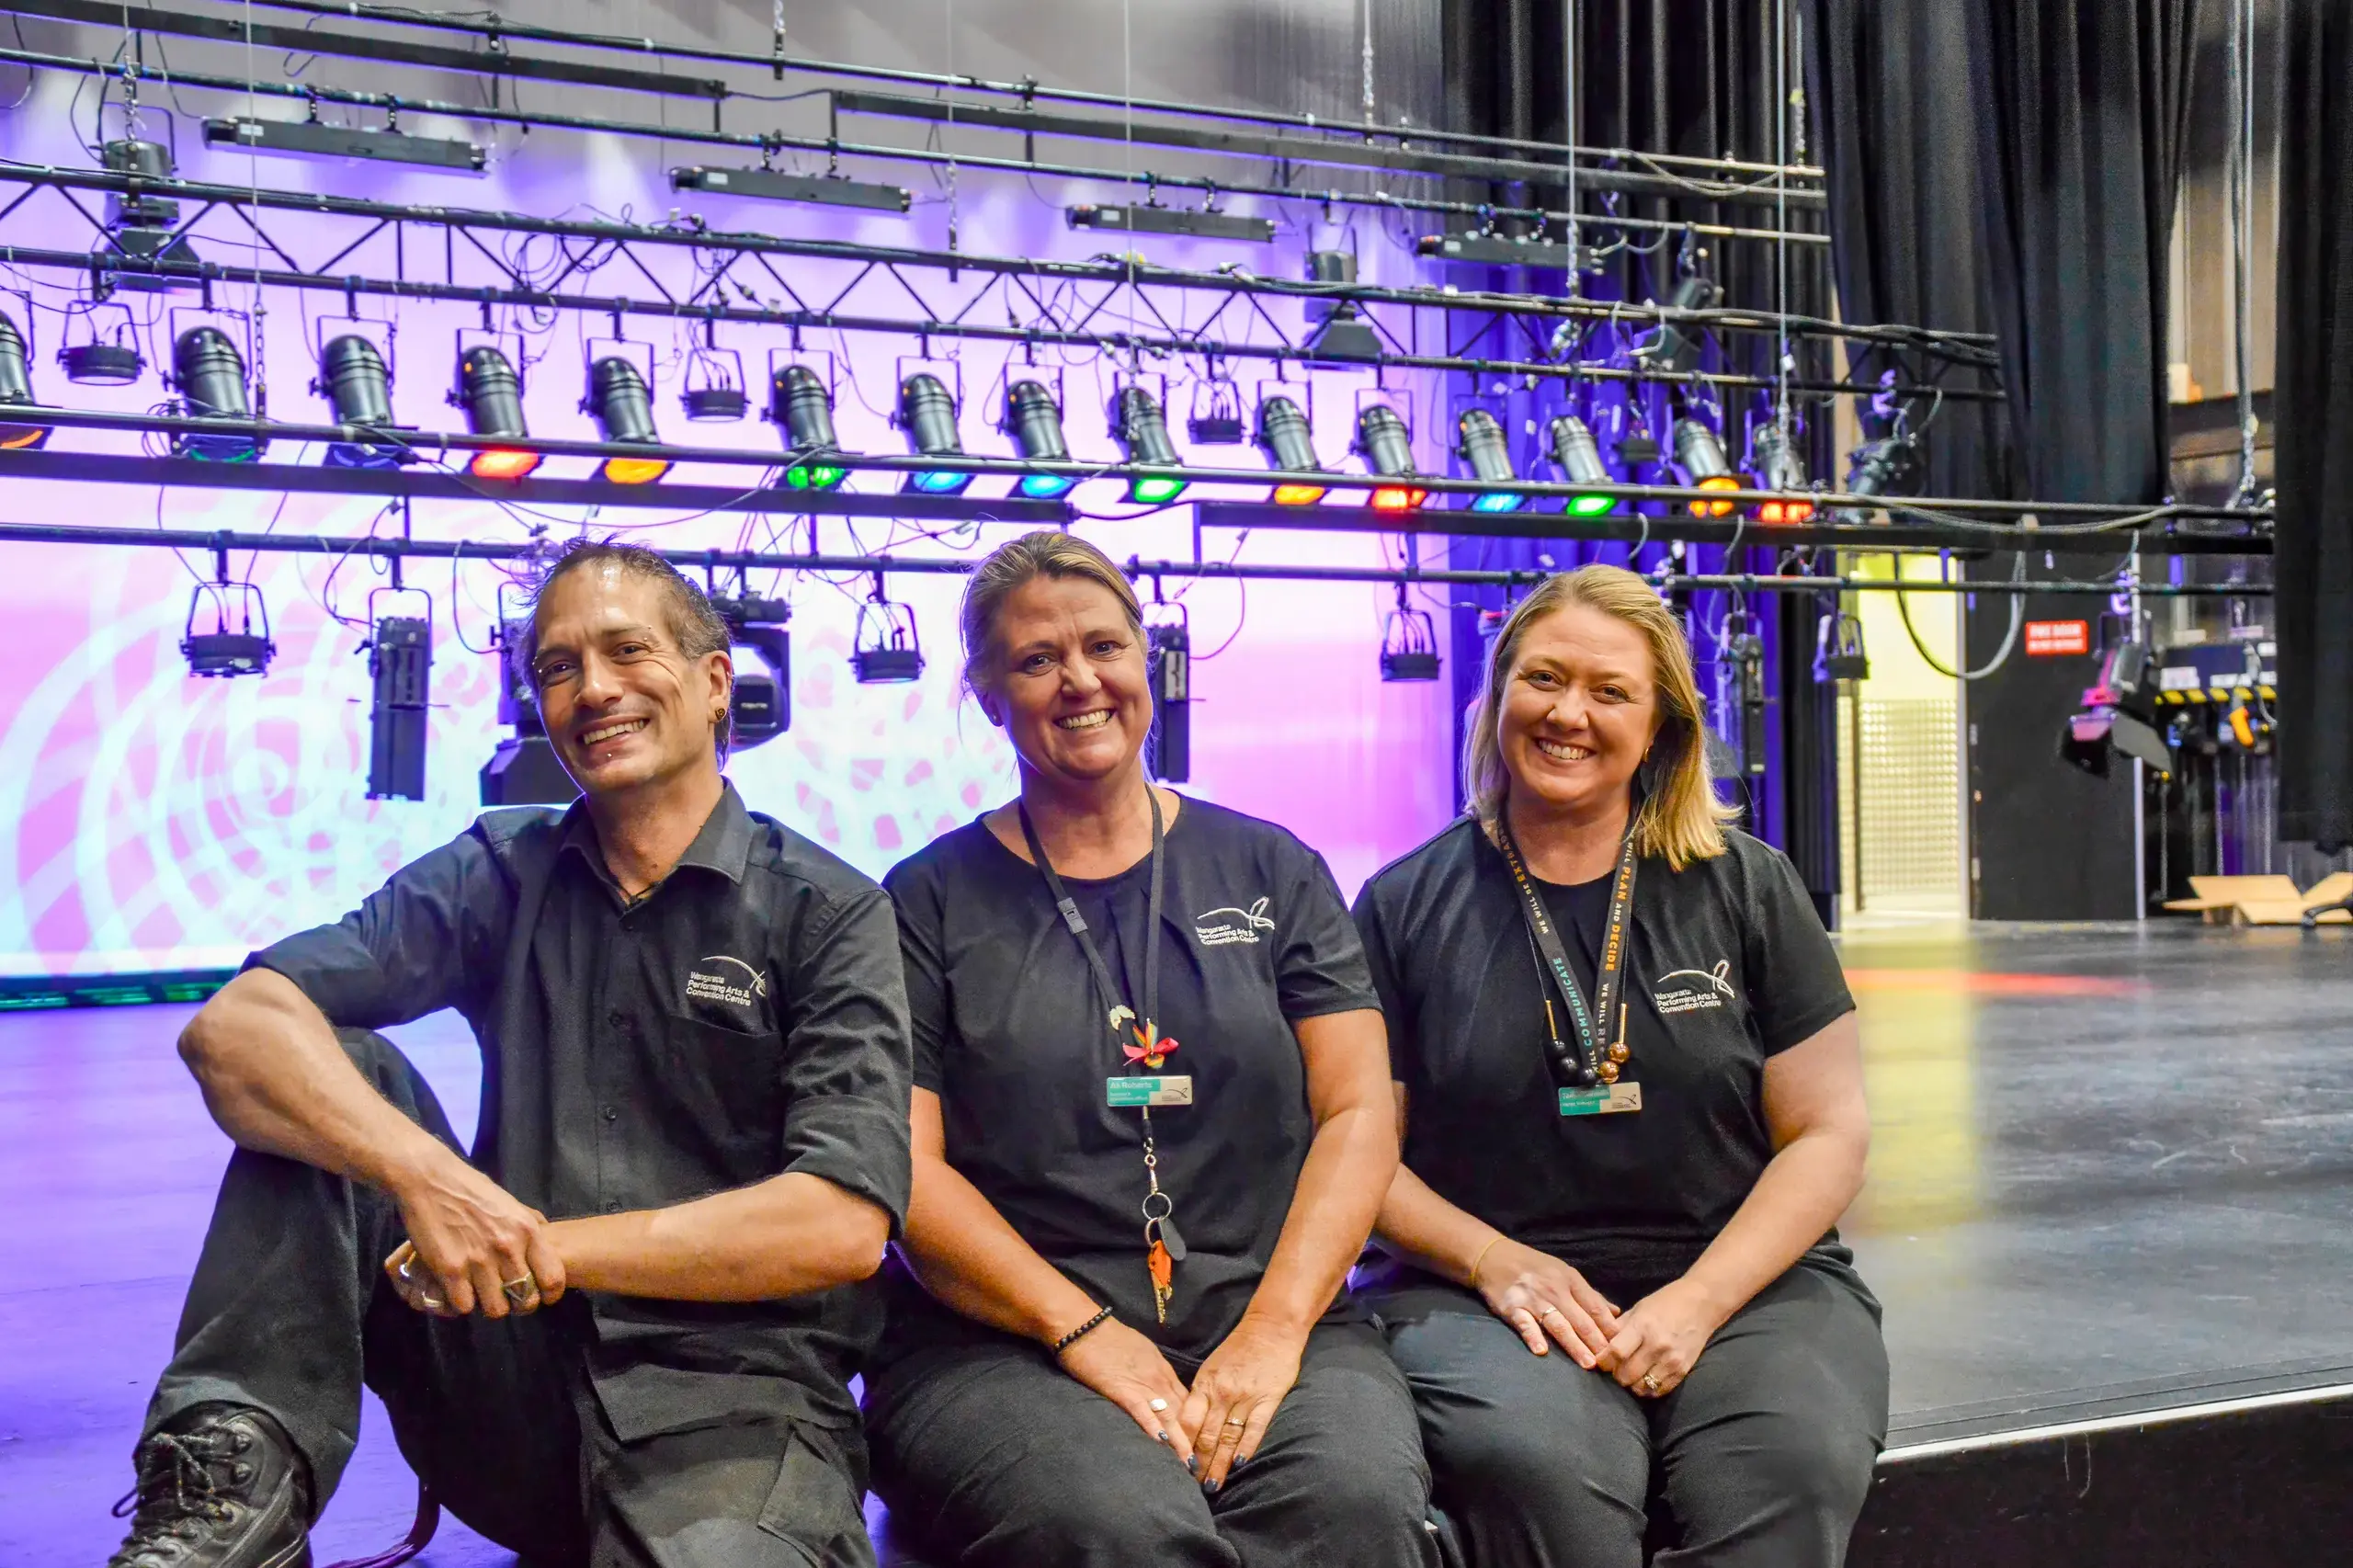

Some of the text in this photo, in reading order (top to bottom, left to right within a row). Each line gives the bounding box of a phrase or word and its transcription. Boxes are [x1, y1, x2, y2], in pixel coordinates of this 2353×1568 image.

[1529, 896, 1542, 918] WILL
[1605, 842, 1633, 971] WILL PLAN AND DECIDE
[1198, 929, 1236, 940] Performing
[1538, 921, 1550, 934] WE
[1200, 936, 1240, 946] Convention
[686, 987, 752, 1006] Convention Centre
[688, 979, 750, 999] Performing Arts &
[1601, 983, 1609, 997] WE
[1552, 957, 1593, 1047] COMMUNICATE
[1656, 992, 1719, 1007] Performing Arts &
[1659, 999, 1722, 1013] Convention Centre
[1598, 1001, 1608, 1024] WILL
